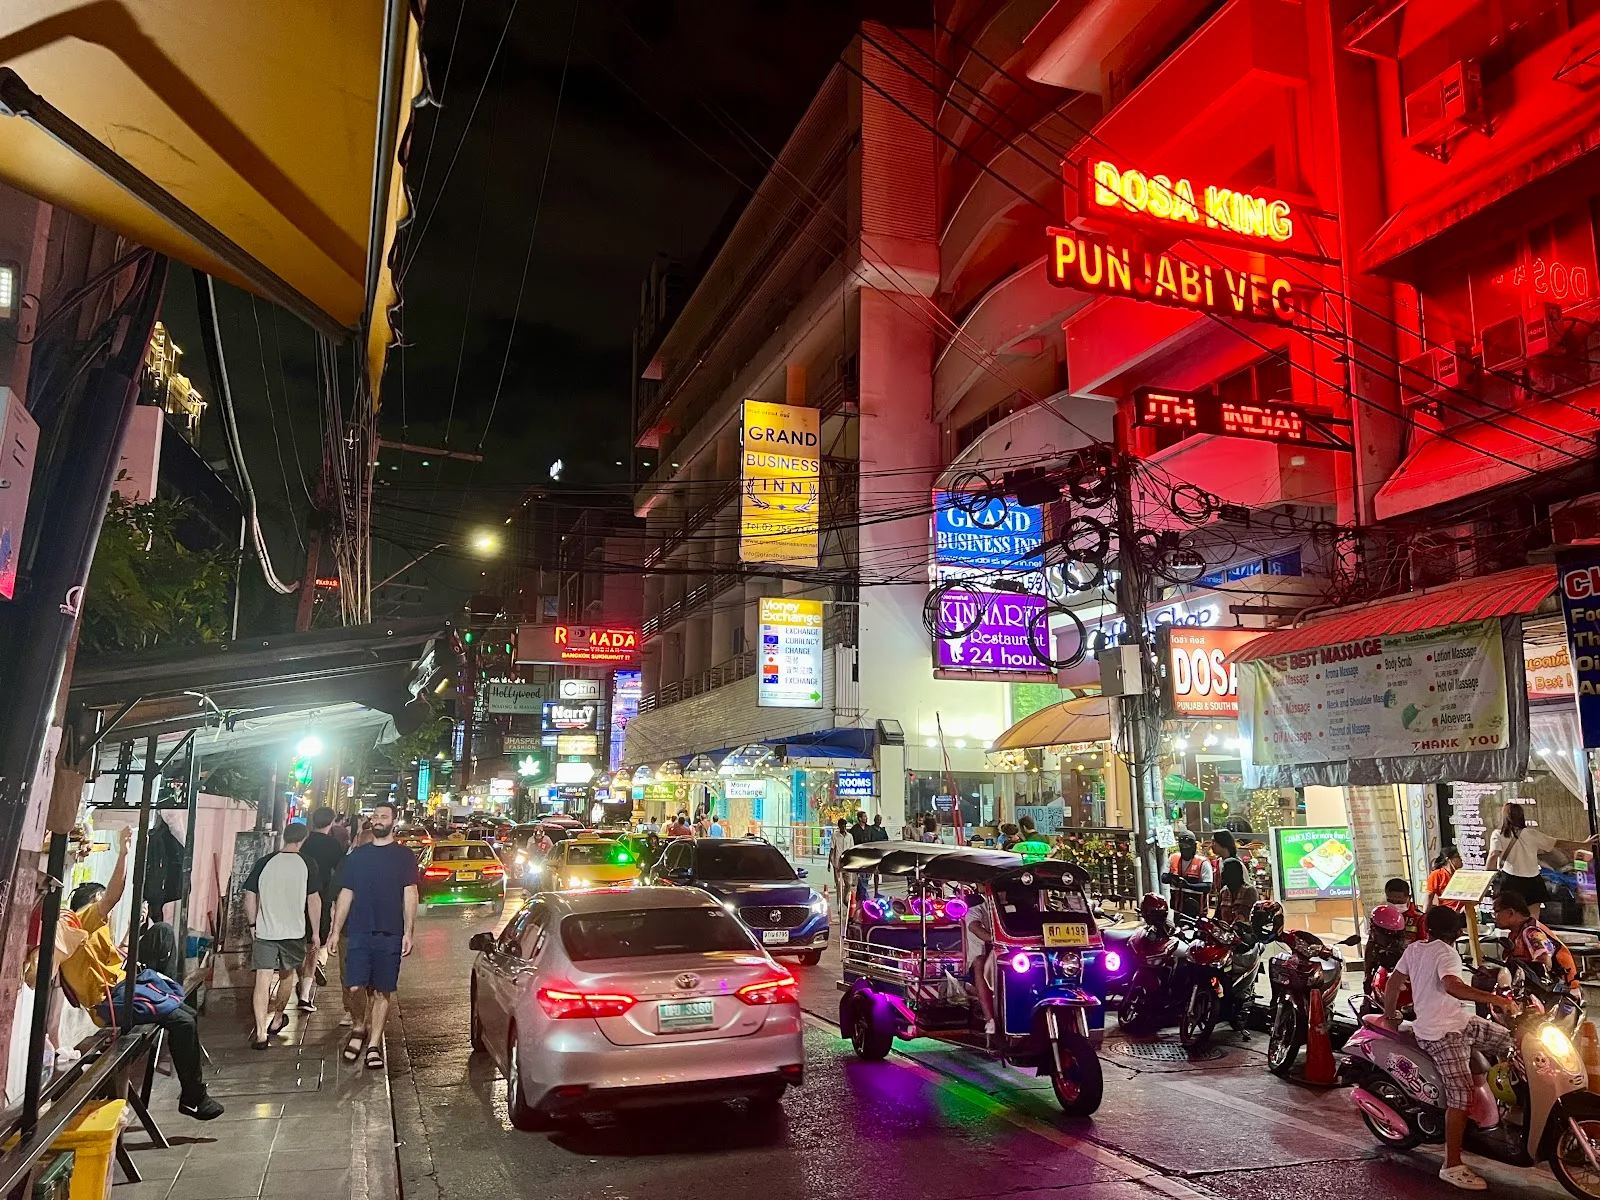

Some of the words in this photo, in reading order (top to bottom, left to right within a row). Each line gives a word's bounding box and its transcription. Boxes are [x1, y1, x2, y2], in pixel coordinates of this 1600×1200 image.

[1094, 161, 1199, 222] DOSA
[1204, 186, 1293, 241] KING
[1056, 235, 1214, 305] PUNJABI
[749, 426, 817, 446] GRAND
[746, 453, 819, 473] BUSINESS
[762, 478, 802, 494] INN
[946, 507, 1031, 532] GRAND
[937, 531, 1010, 554] BUSINESS
[762, 599, 800, 613] Money
[762, 610, 821, 626] Exchange
[1155, 608, 1210, 627] Shop
[555, 626, 635, 647] RMADA
[785, 628, 819, 636] EXCHANGE
[785, 637, 820, 646] CURRENCY
[785, 647, 811, 655] CHANGE
[969, 647, 993, 664] 24
[1290, 650, 1317, 669] BEST
[1321, 638, 1382, 664] MASSAGE
[1433, 650, 1451, 663] Lotion
[1451, 646, 1477, 659] Massage
[1384, 657, 1397, 672] Body
[1397, 654, 1413, 669] Scrub
[1285, 673, 1310, 686] Massage
[1325, 668, 1339, 680] Aroma
[1339, 665, 1359, 679] Massage
[1436, 680, 1448, 693] Hot
[1454, 677, 1479, 691] Massage
[1535, 675, 1563, 690] Best
[491, 686, 542, 704] Hollywood
[1326, 699, 1339, 709] Neck
[1340, 699, 1349, 708] and
[1349, 696, 1372, 707] Shoulder
[1176, 701, 1204, 711] PUNJABI
[1210, 701, 1231, 711] SOUTH
[1285, 701, 1311, 715] Massage
[1440, 712, 1471, 725] Aloevera
[1352, 723, 1371, 738] Massage
[1411, 738, 1459, 751] THANK
[1468, 735, 1499, 746] YOU
[730, 781, 751, 789] Money
[839, 777, 872, 788] ROOMS
[730, 789, 763, 798] Exchange
[1284, 832, 1312, 844] FAMOUS
[1333, 831, 1346, 840] than
[1329, 888, 1336, 896] On
[1065, 926, 1086, 936] 4199
